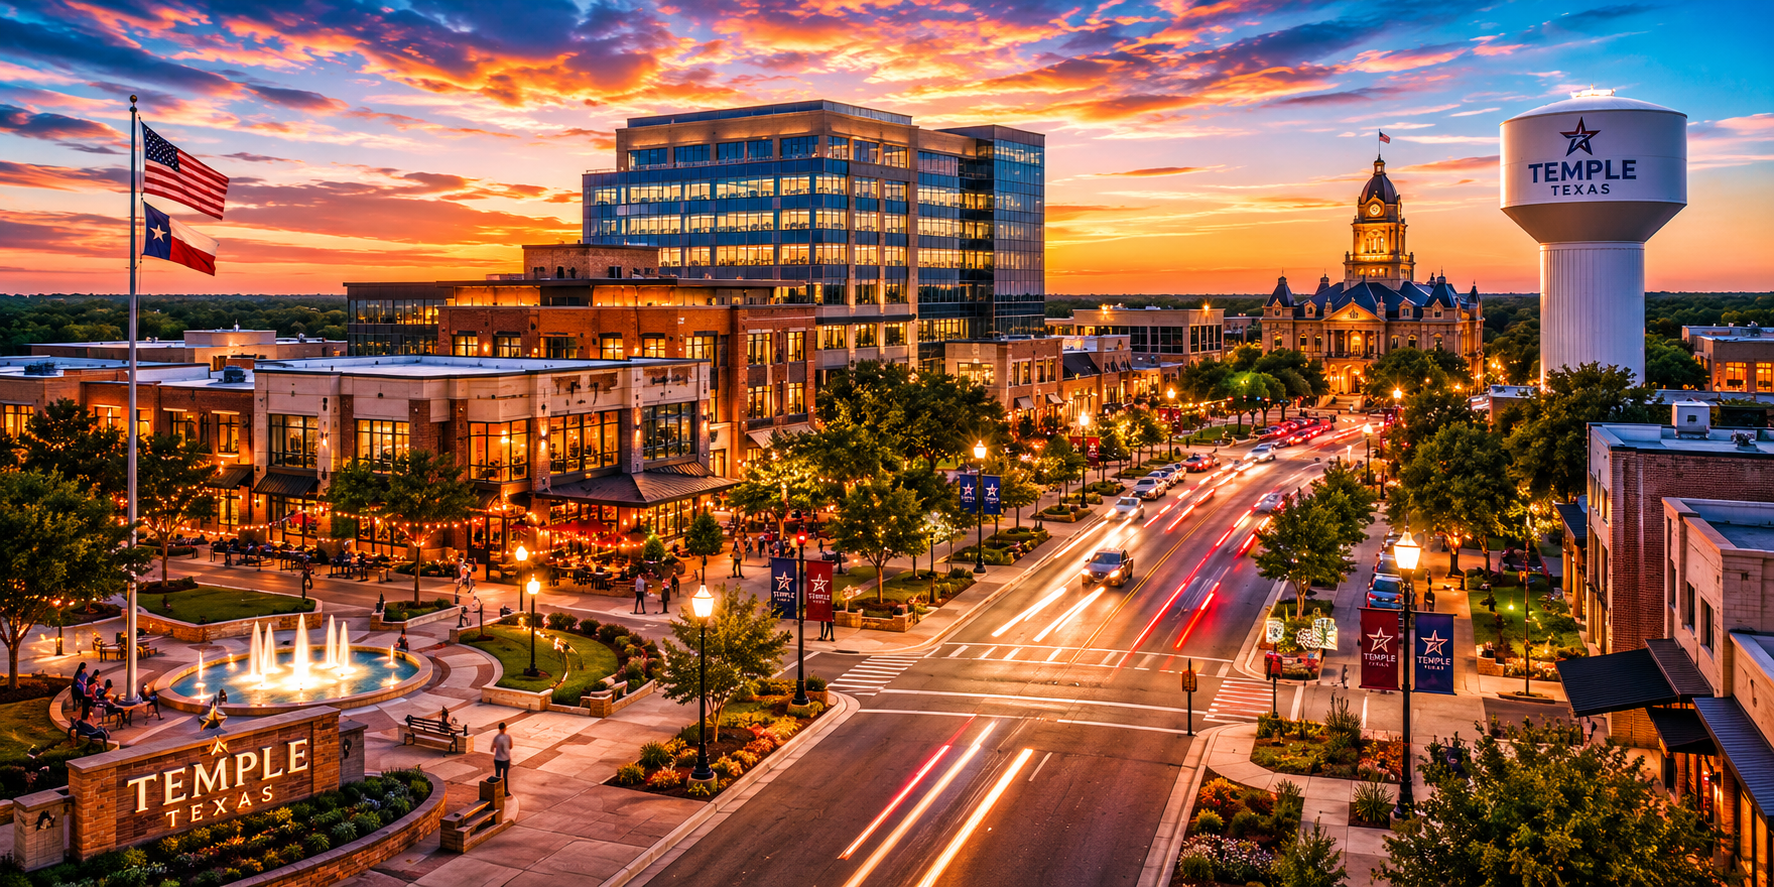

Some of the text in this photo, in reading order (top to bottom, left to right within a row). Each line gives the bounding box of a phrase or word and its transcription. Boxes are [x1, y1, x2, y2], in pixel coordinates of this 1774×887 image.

[1528, 159, 1637, 183] TEMPLE
[1551, 183, 1610, 196] TEXAS
[1363, 653, 1396, 662] TEMPLE
[1417, 656, 1451, 665] TEMPLE
[126, 738, 309, 813] TEMPLE
[165, 784, 273, 828] TEXAS
